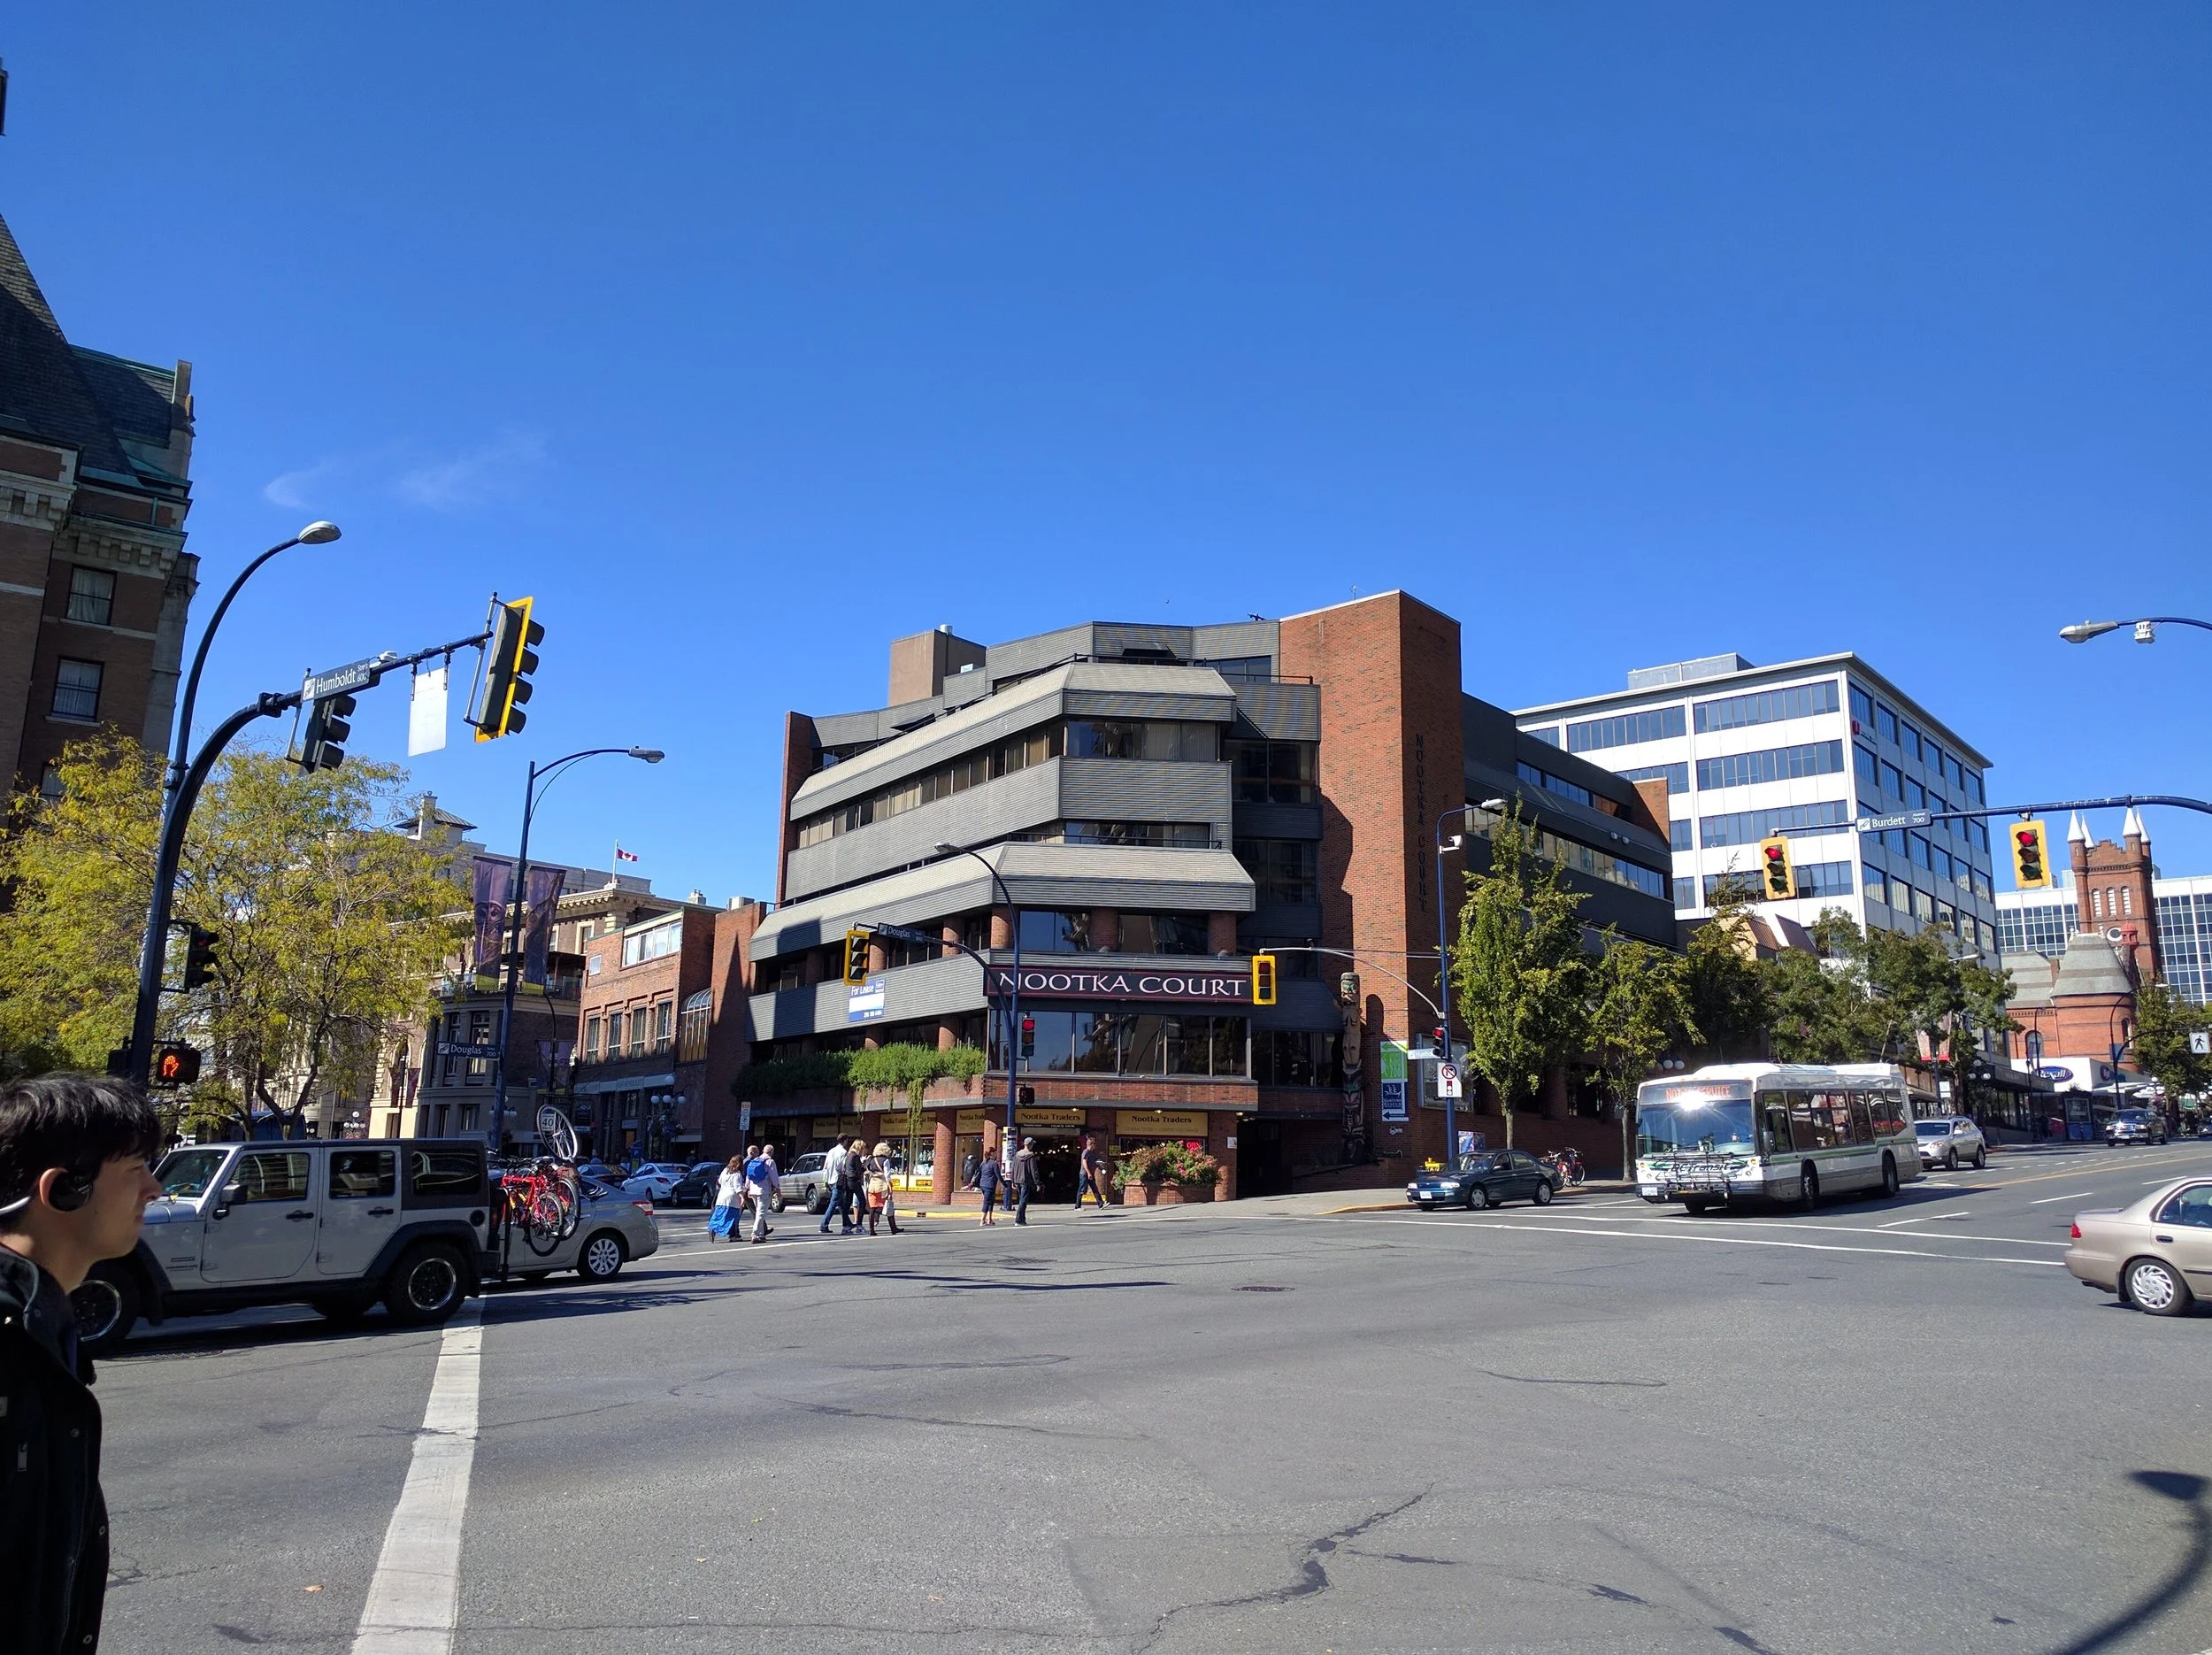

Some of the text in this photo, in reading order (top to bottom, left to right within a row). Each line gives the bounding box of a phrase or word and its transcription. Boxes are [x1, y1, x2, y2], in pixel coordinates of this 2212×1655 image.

[316, 668, 356, 694] Humboldt
[1416, 735, 1426, 912] NOOTKA COURT
[1872, 817, 1906, 828] Burdett
[888, 926, 910, 937] Douglas
[859, 984, 874, 995] Lease
[1000, 973, 1247, 996] NOOTKA COURT
[450, 1044, 482, 1055] Douglas
[2037, 1070, 2066, 1080] Rexall
[1665, 1088, 1680, 1098] NOT
